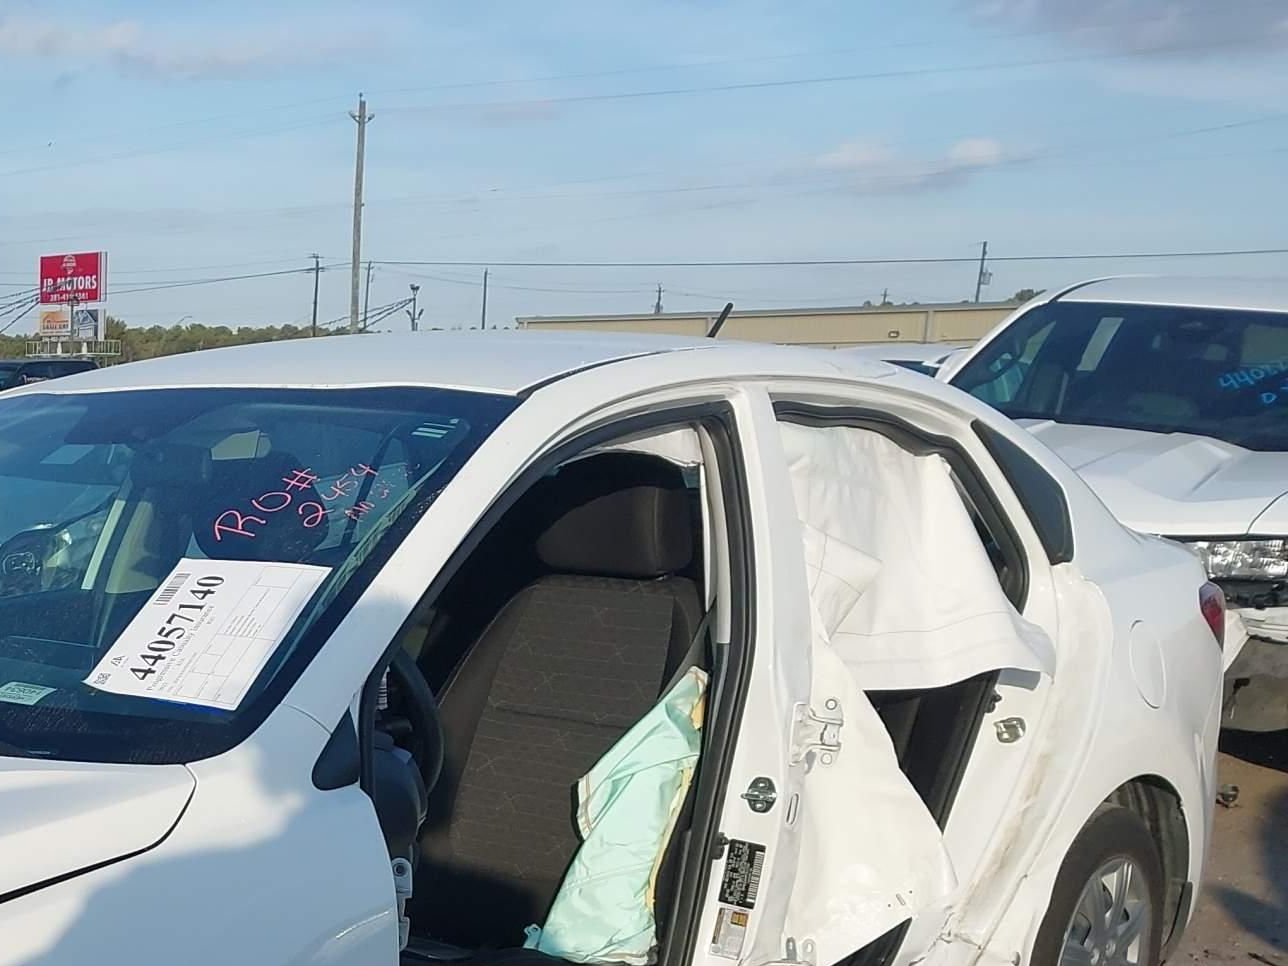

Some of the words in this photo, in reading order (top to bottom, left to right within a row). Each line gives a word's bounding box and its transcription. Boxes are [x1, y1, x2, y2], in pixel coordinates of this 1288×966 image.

[56, 275, 97, 292] MOTORS
[215, 468, 320, 541] RO#
[298, 463, 379, 528] 2454
[130, 576, 225, 680] 44057140
